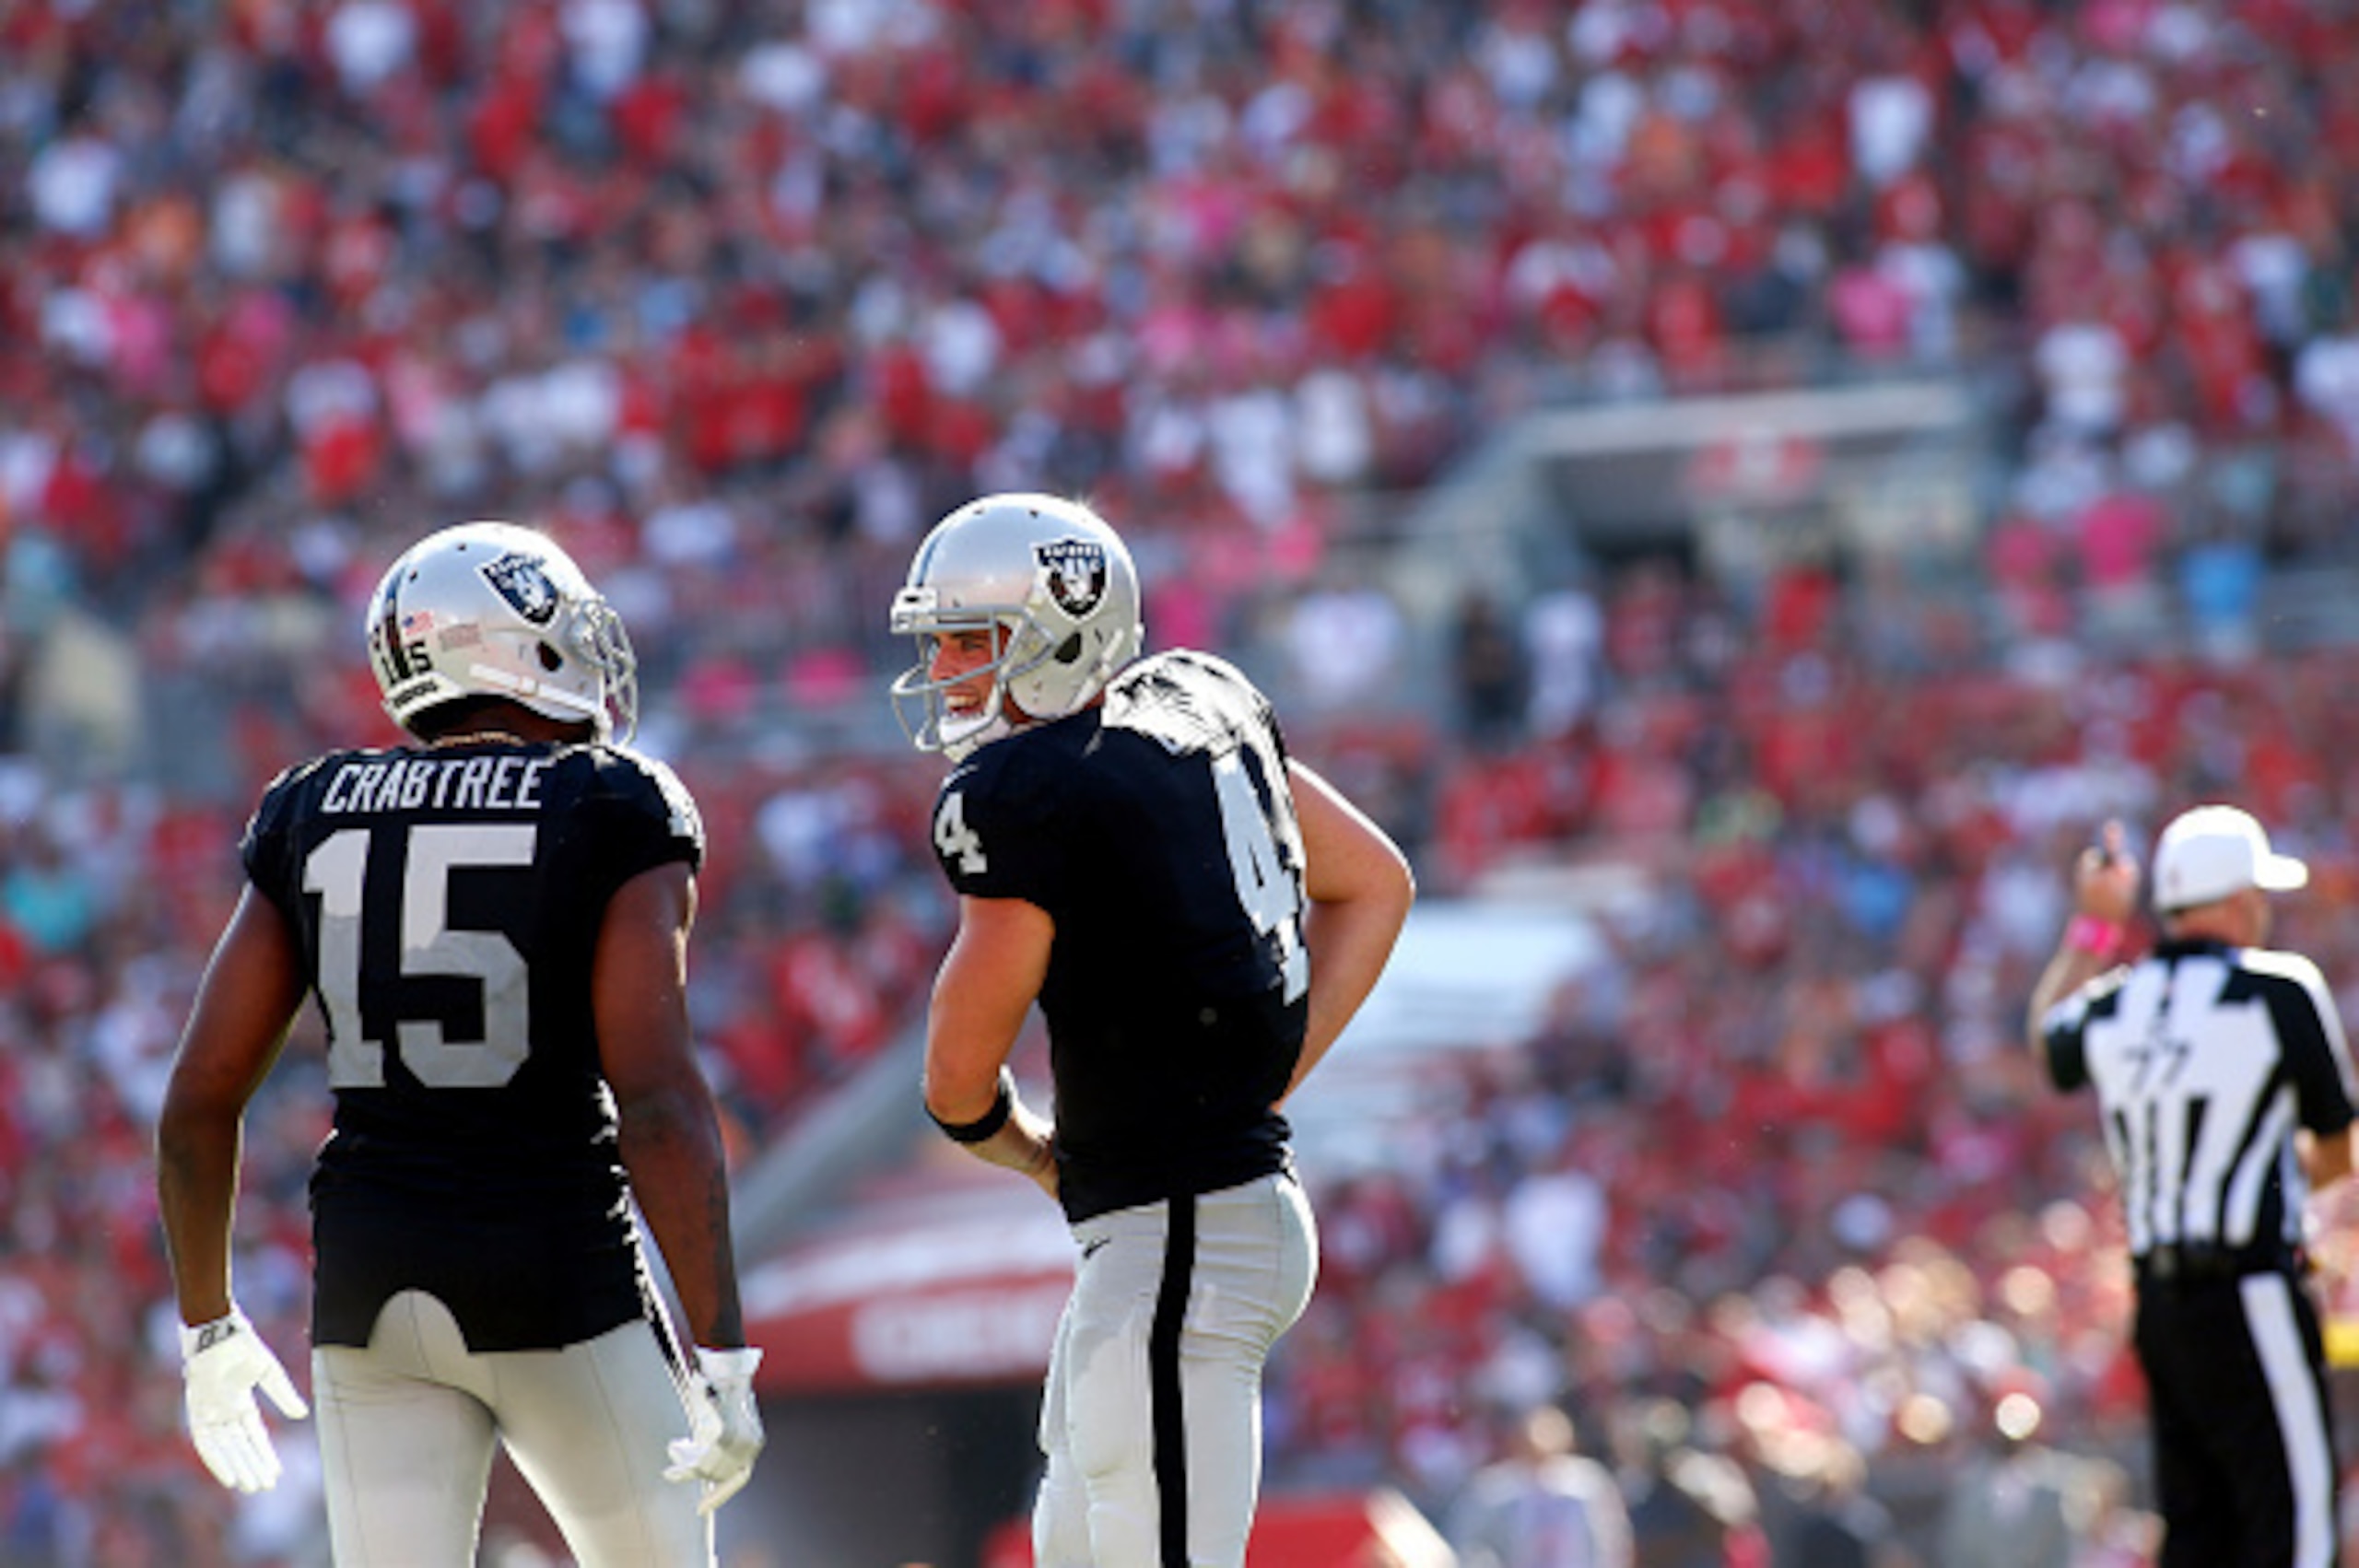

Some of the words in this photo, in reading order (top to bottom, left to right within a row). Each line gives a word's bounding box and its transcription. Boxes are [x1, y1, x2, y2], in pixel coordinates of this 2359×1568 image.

[321, 756, 546, 813] CRABTREE
[933, 790, 988, 874] 4
[1209, 750, 1310, 1007] 4
[301, 824, 538, 1088] 15
[2121, 1038, 2193, 1093] 77
